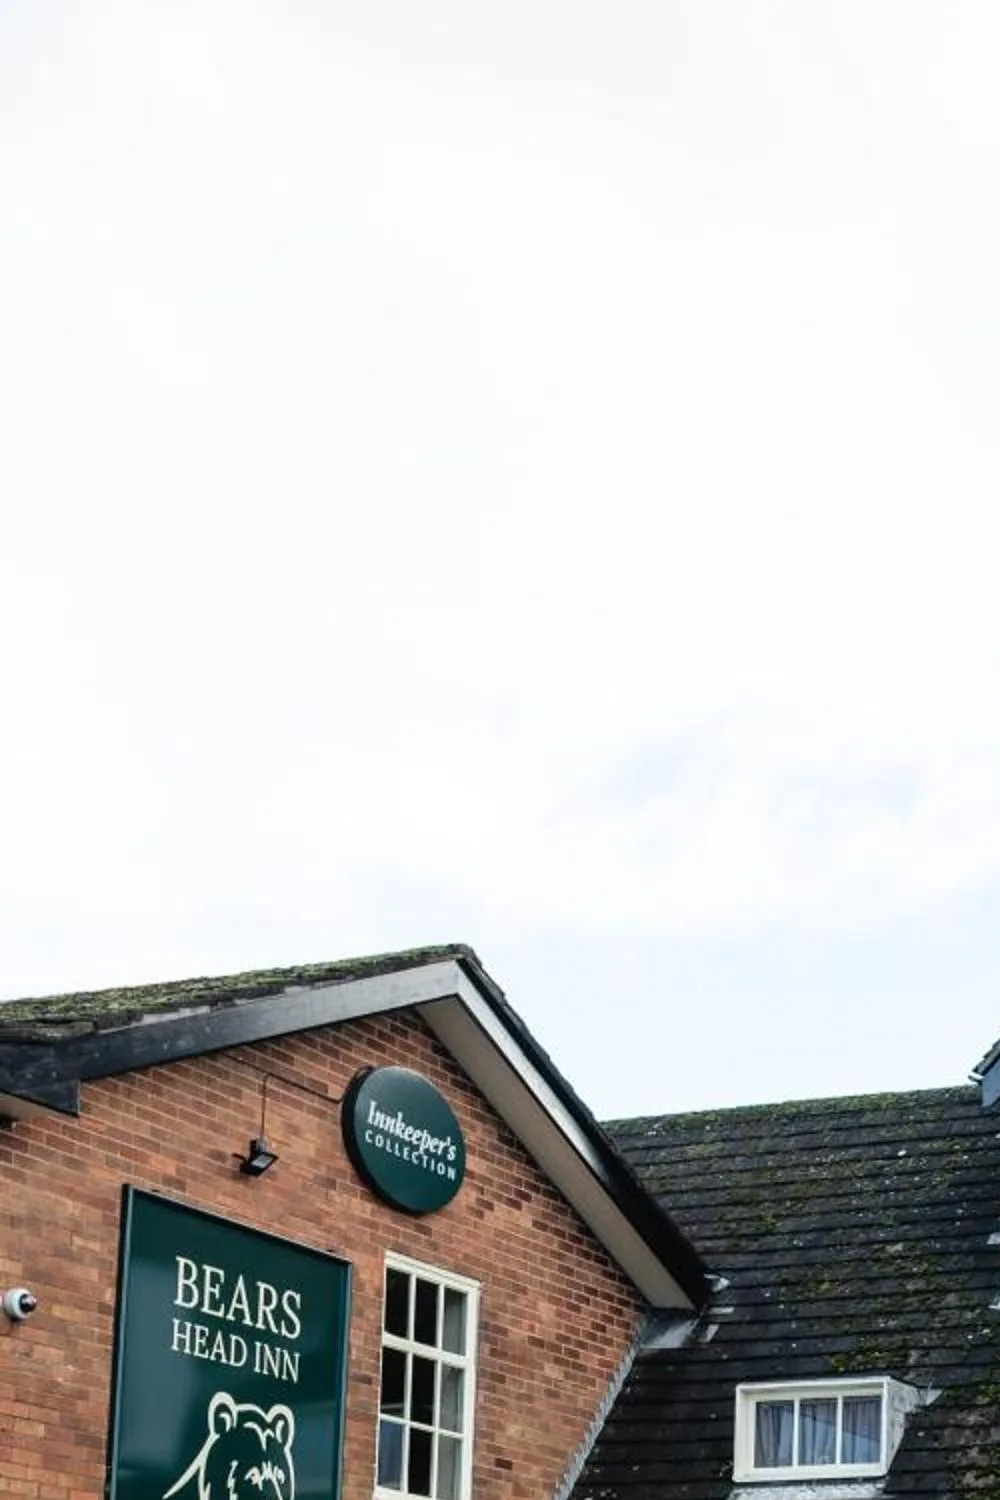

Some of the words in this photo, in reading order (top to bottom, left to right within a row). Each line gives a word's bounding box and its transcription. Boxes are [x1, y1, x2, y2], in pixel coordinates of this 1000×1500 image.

[365, 1129, 457, 1181] COLLECTION
[367, 1100, 457, 1161] Innkeeper's
[173, 1255, 301, 1339] BEARS
[171, 1317, 248, 1368] HEAD
[253, 1341, 301, 1385] INN
